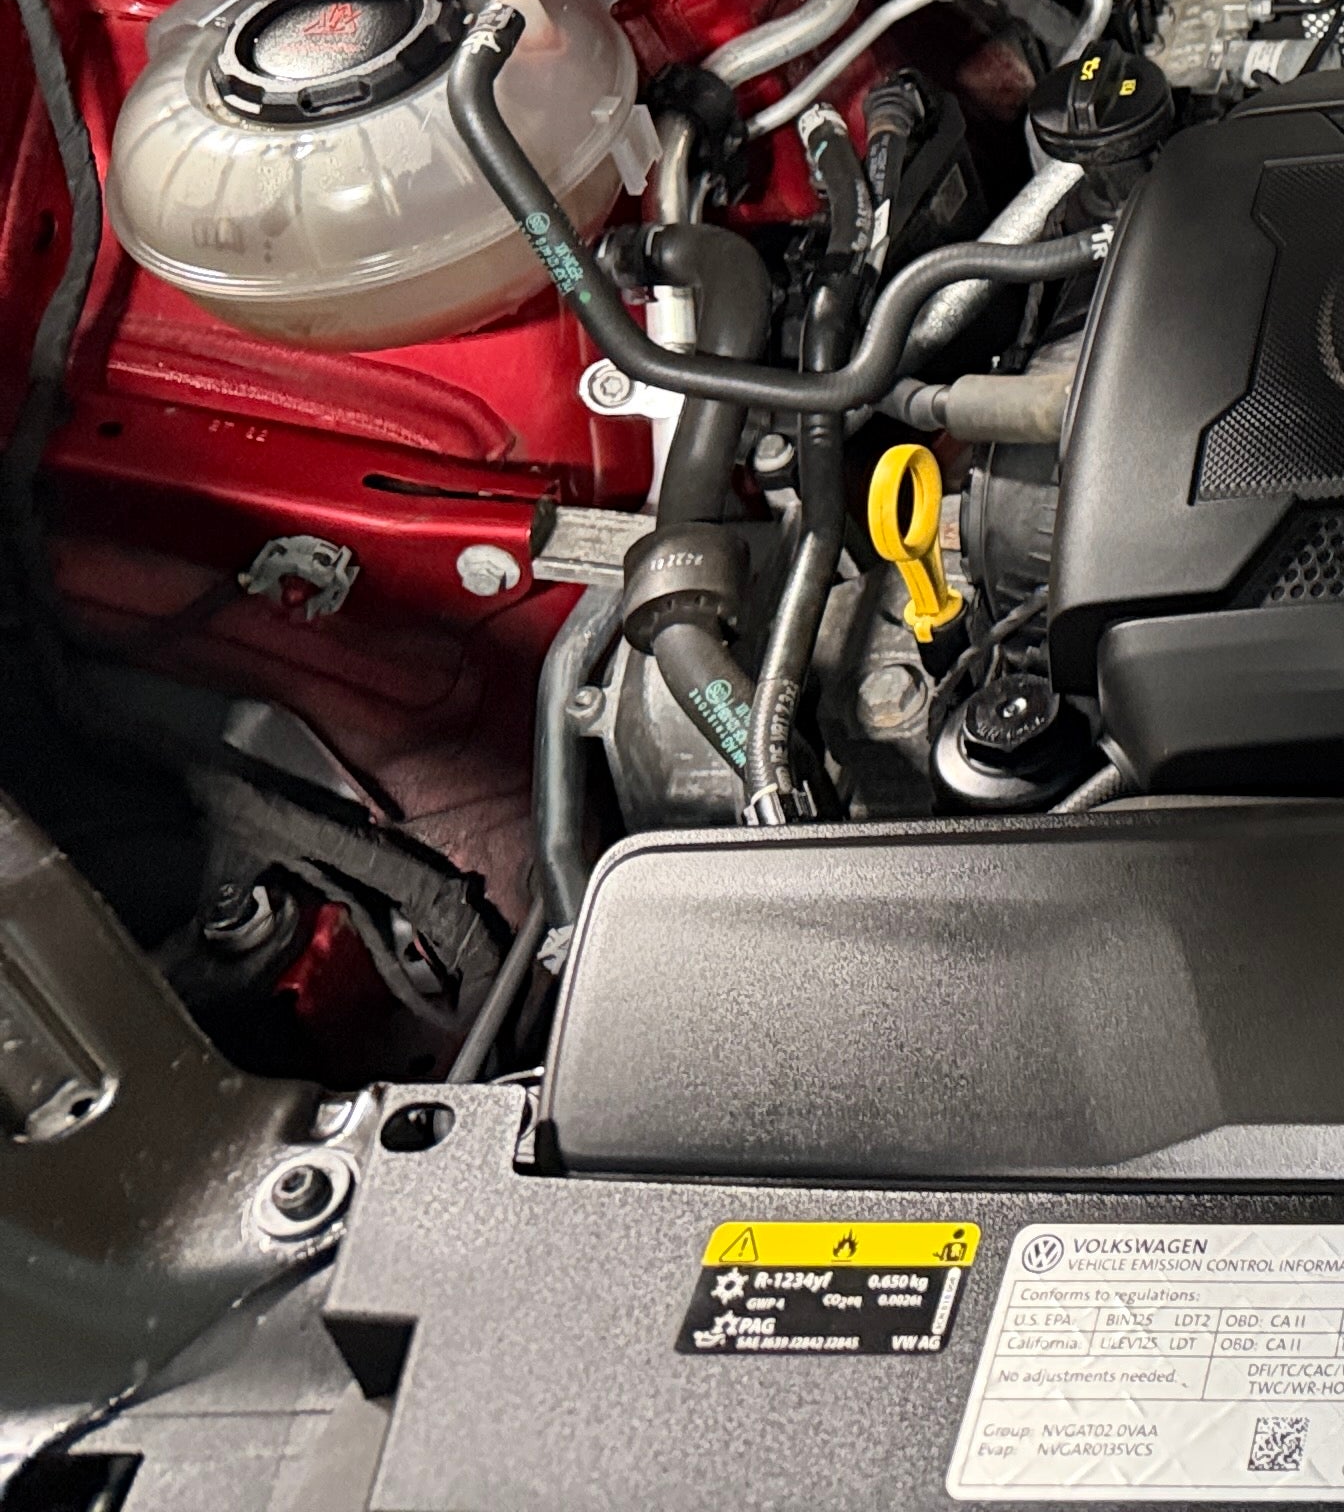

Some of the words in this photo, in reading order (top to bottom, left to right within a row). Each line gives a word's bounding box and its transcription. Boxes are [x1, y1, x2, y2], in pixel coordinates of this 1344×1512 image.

[1073, 1238, 1208, 1254] VOLKSWAGEN
[1068, 1259, 1126, 1270] VEHICLE
[1130, 1259, 1202, 1271] EMISSION
[1206, 1259, 1274, 1272] CONTROL
[754, 1271, 833, 1293] R-1234yf
[909, 1274, 929, 1292] kg
[1020, 1289, 1090, 1301] Conforms
[1094, 1289, 1110, 1302] to
[1114, 1289, 1200, 1303] regulations:
[739, 1317, 776, 1335] PAG
[1174, 1314, 1211, 1327] LDT2
[1225, 1315, 1263, 1327] OBD:
[1270, 1315, 1290, 1328] CA
[891, 1335, 917, 1350] VW
[917, 1335, 942, 1350] AG
[1168, 1338, 1197, 1350] LDT
[1220, 1339, 1257, 1351] OBD:
[1265, 1339, 1286, 1351] CA
[997, 1369, 1019, 1382] No
[1022, 1369, 1115, 1383] adjustments
